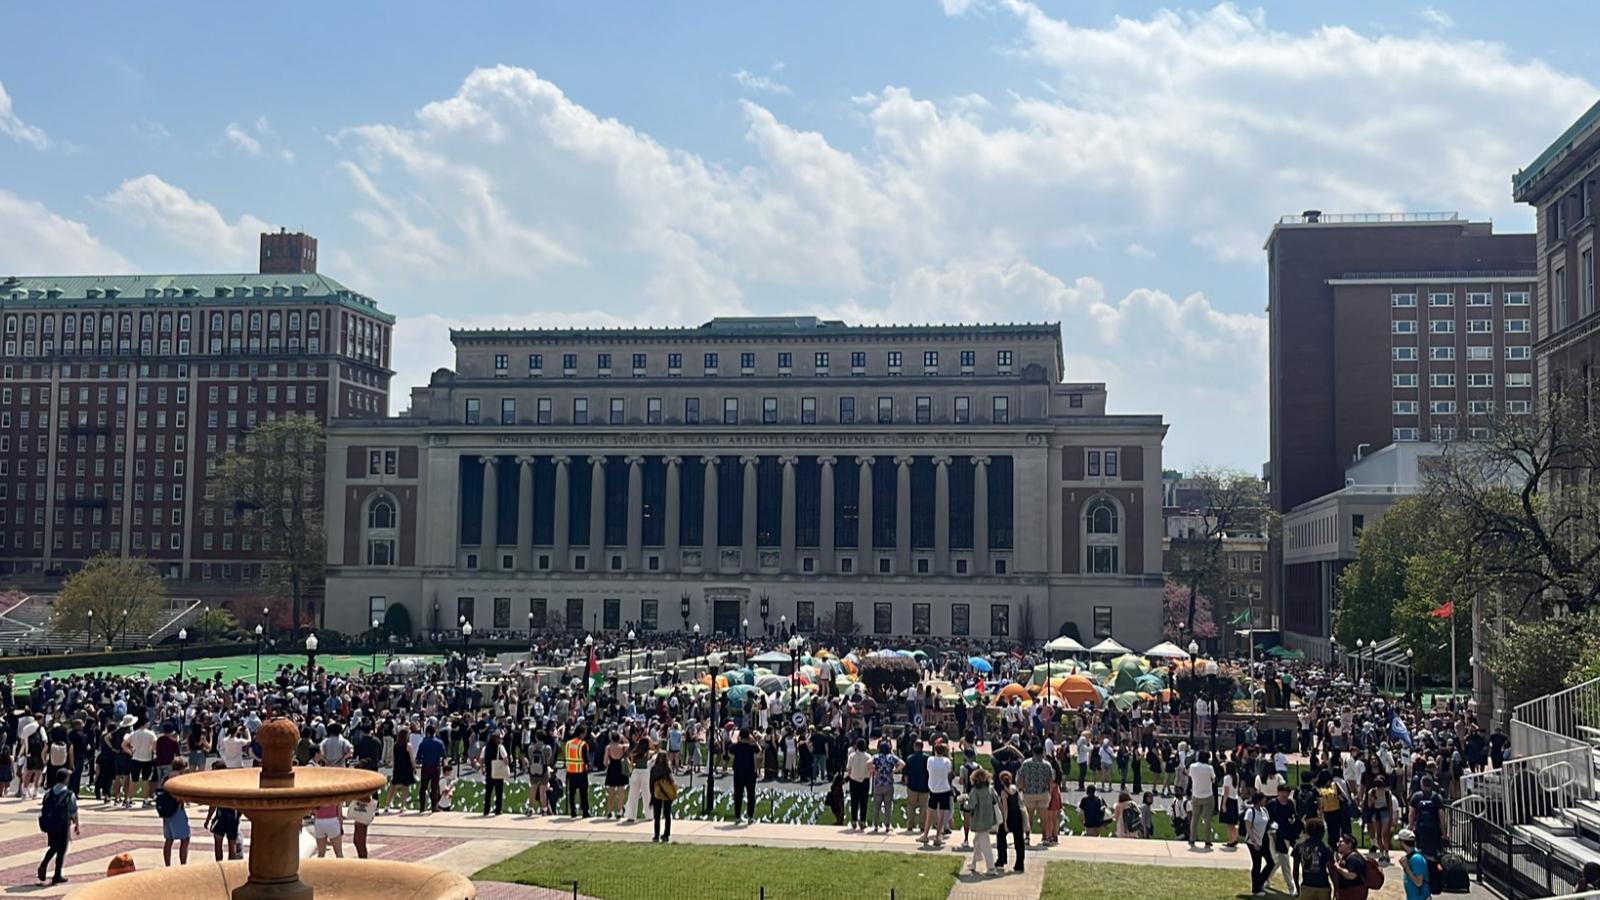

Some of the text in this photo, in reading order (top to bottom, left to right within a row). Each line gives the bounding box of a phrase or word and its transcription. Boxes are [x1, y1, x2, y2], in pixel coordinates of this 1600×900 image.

[496, 435, 973, 445] HOMER HERODOTUS SOPHOCLES PLATO ARISTOTLE DEMOSTHENES CICERO VERGIL
